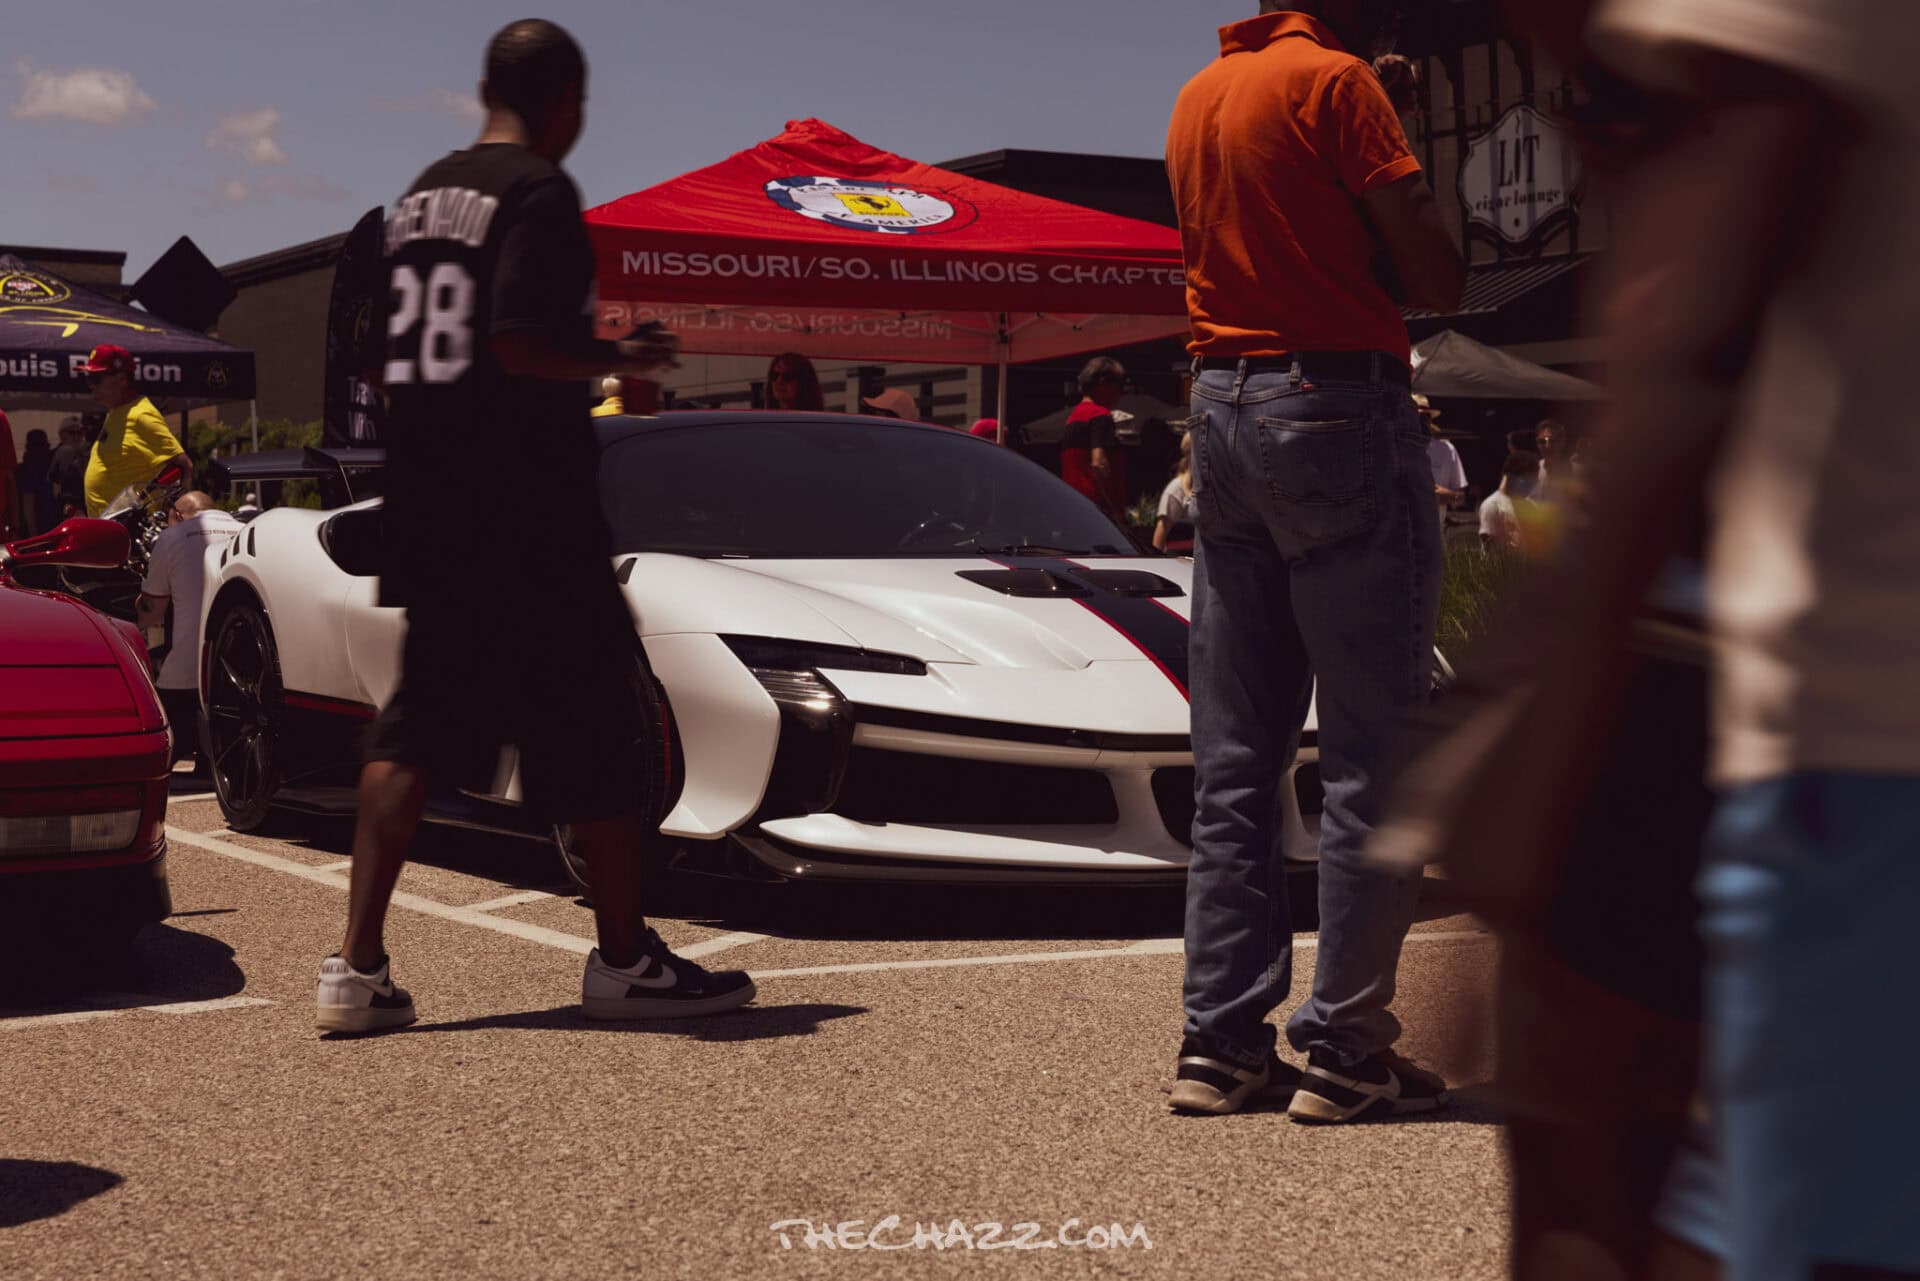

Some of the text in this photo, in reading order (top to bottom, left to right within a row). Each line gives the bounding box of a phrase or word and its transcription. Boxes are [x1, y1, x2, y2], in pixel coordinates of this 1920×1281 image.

[1513, 188, 1561, 206] lounge
[621, 250, 1187, 286] MISSOURI/SO. ILLINOIS CHAPTE
[383, 261, 476, 384] 28
[68, 354, 182, 382] Rion
